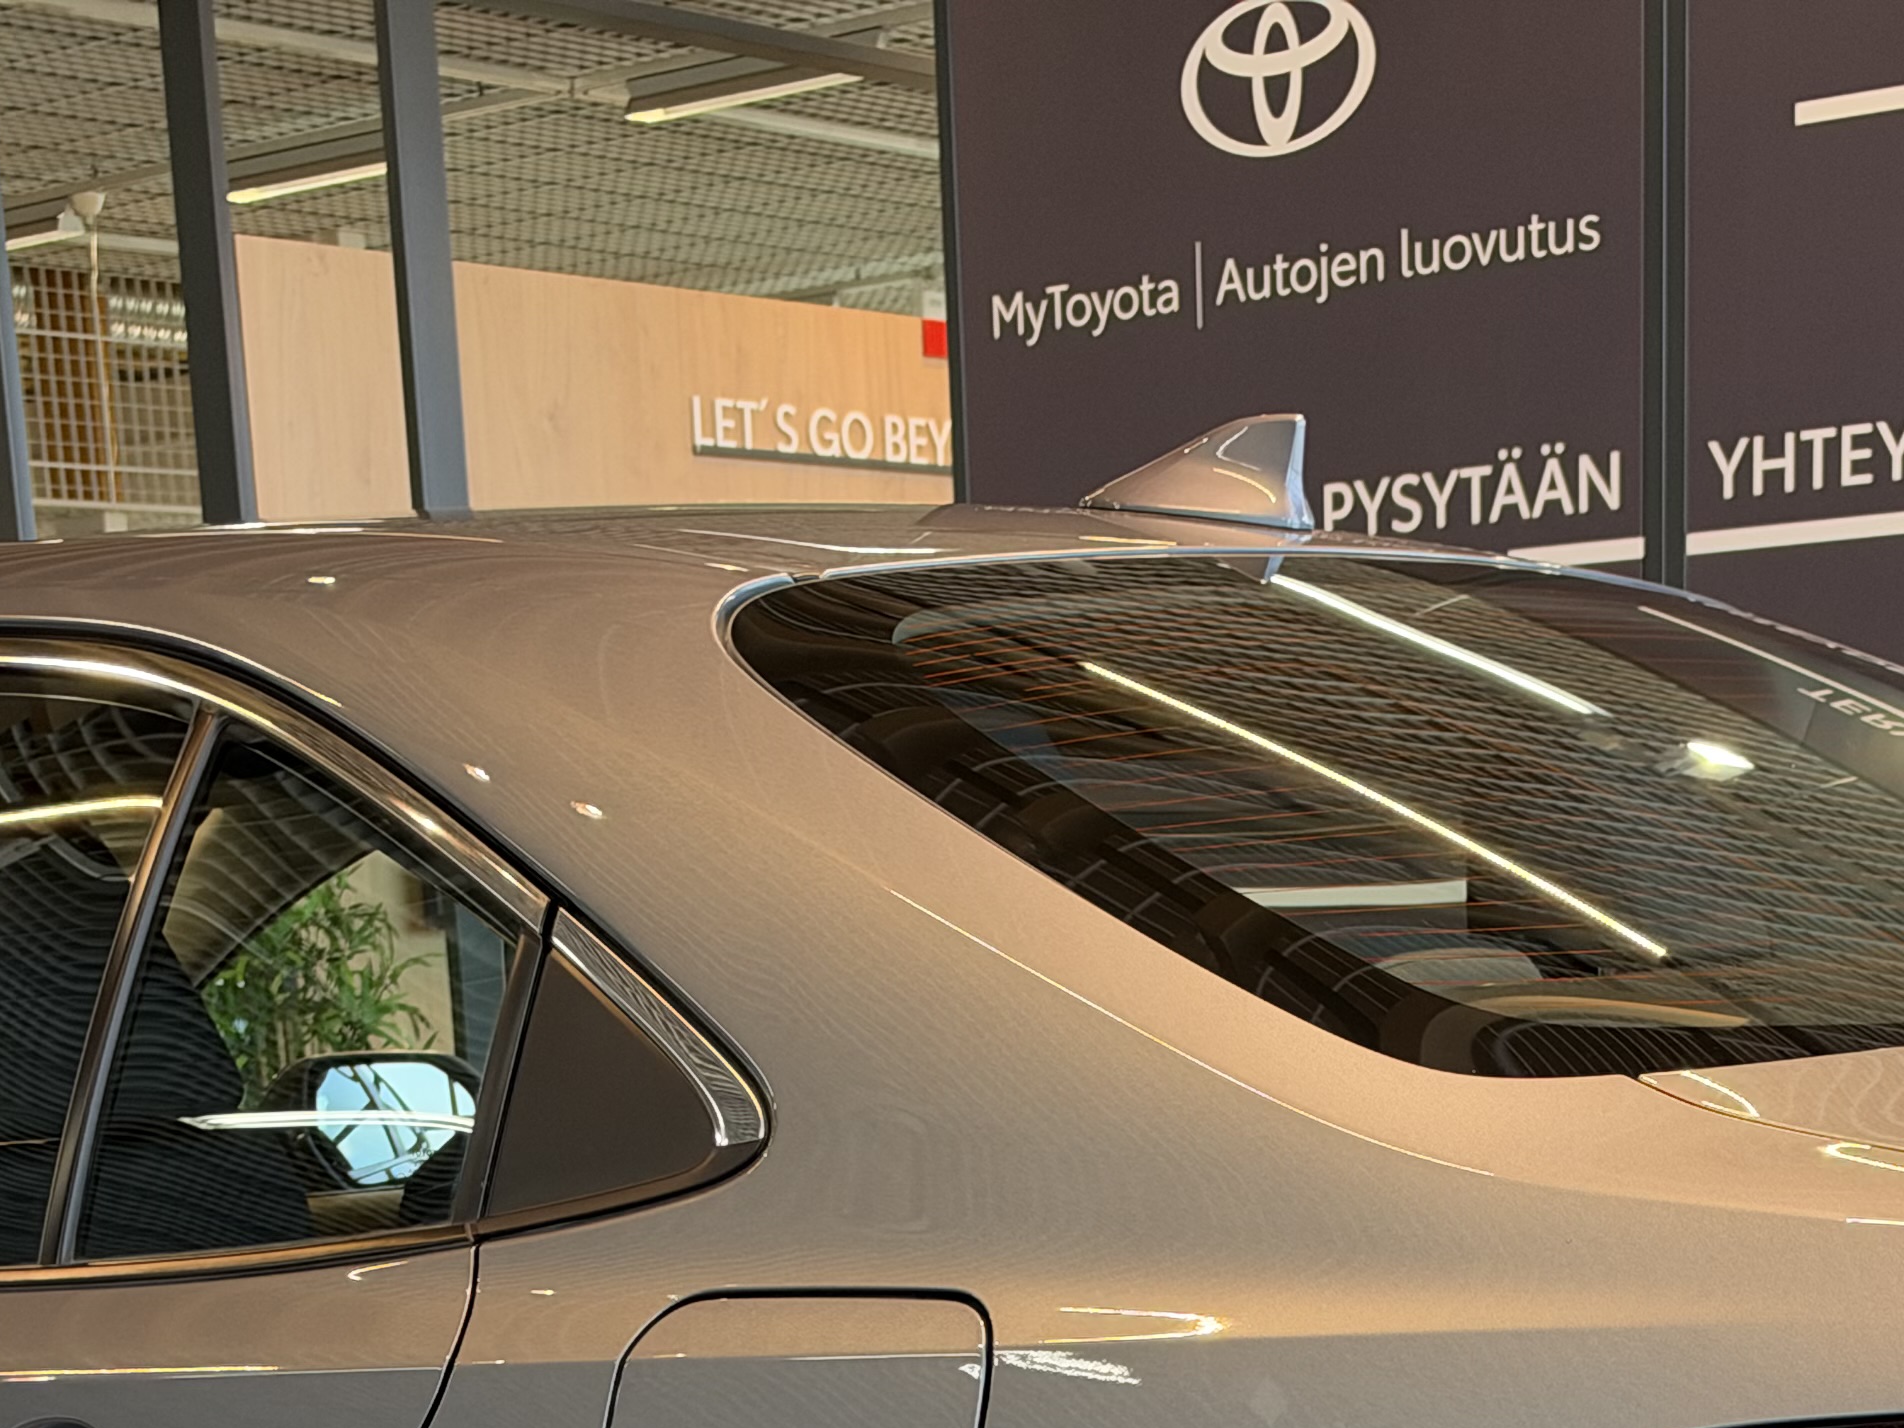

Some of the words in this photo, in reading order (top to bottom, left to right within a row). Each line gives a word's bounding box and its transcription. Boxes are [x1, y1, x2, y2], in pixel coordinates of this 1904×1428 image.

[992, 275, 1180, 346] MyToyota
[1215, 242, 1385, 304] Autojen
[1400, 213, 1601, 279] luovutus
[809, 407, 875, 460] GO
[1322, 441, 1621, 537] PYSYTÄÄN
